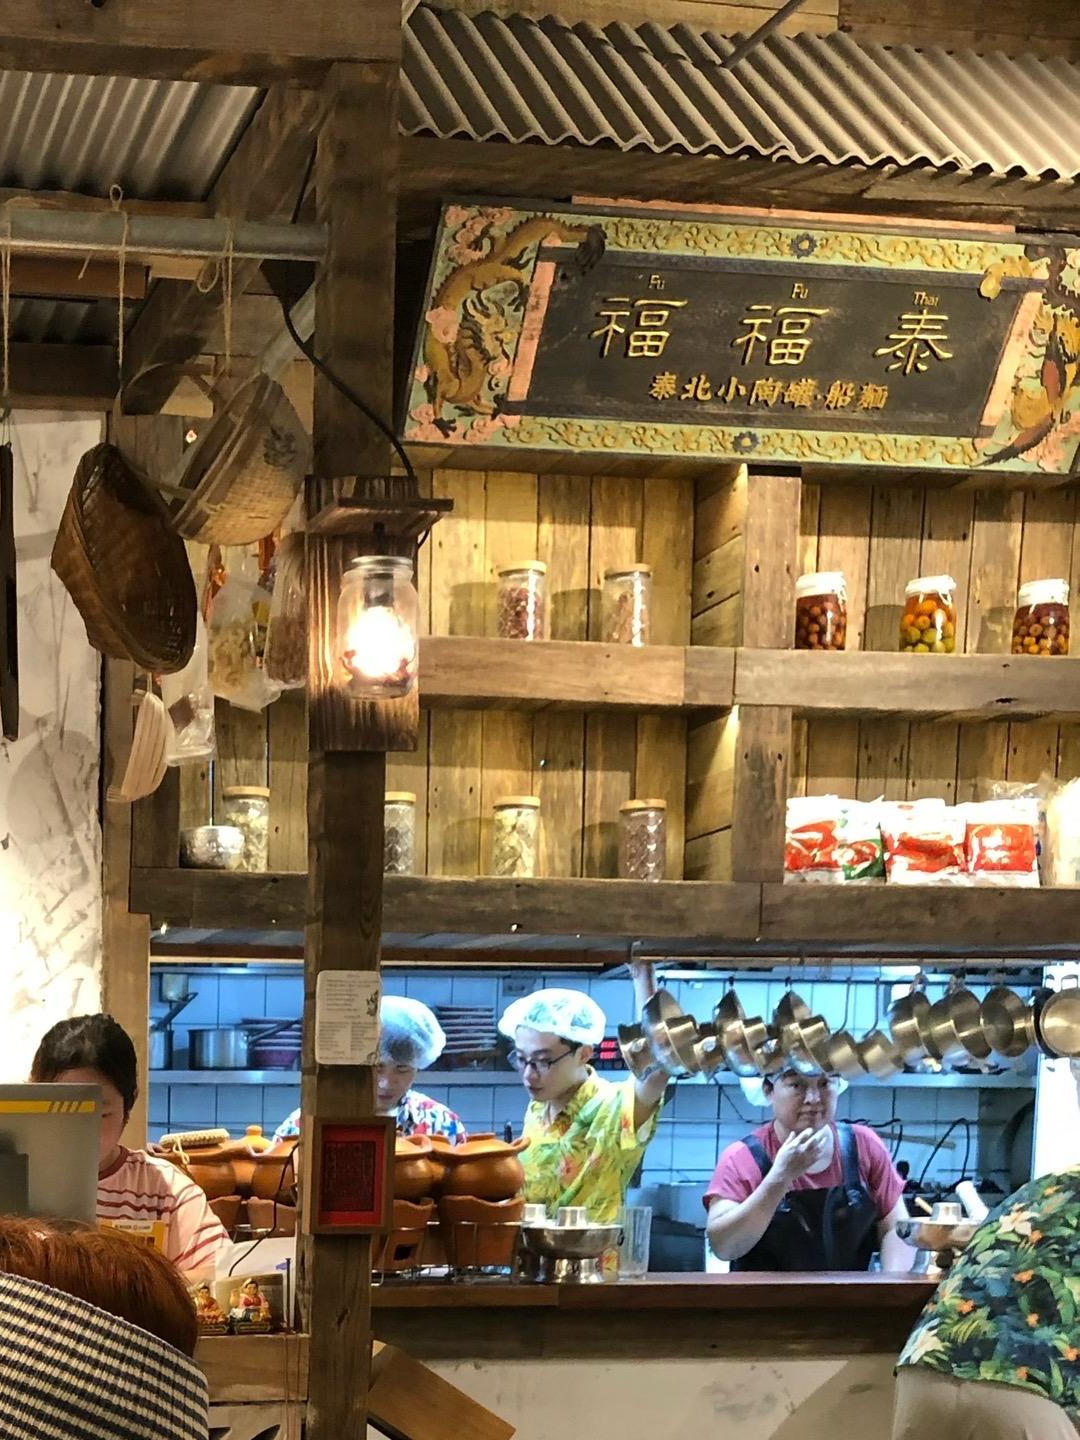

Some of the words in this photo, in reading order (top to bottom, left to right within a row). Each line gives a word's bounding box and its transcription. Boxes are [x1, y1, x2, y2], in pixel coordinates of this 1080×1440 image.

[649, 274, 665, 290] Fu
[792, 283, 808, 299] Fu
[914, 291, 939, 307] Thai
